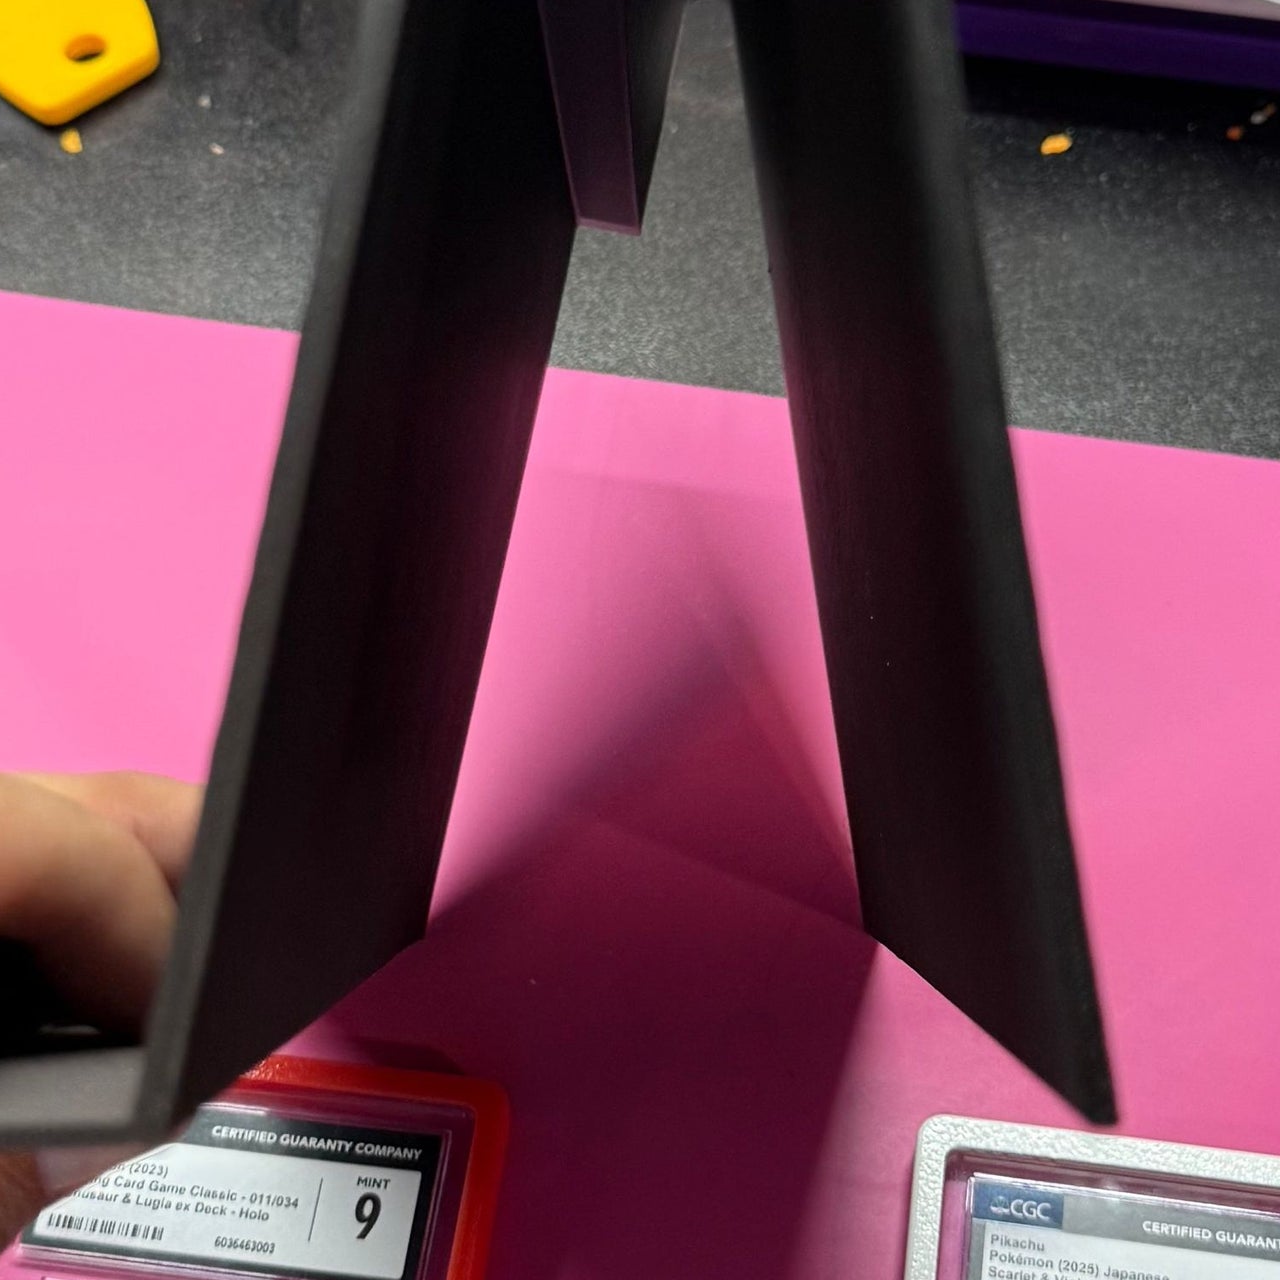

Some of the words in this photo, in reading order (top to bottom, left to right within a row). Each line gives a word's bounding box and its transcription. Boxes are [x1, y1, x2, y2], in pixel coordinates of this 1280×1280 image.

[211, 1124, 278, 1144] CERTIFIED
[279, 1132, 354, 1153] GUARANTY
[354, 1141, 423, 1161] COMPANY
[128, 1163, 169, 1179] (2023)
[113, 1175, 145, 1192] Card
[148, 1179, 187, 1196] Game
[189, 1184, 238, 1202] Classic
[249, 1191, 300, 1210] 011/034
[356, 1175, 392, 1191] MINT
[73, 1188, 119, 1206] nusaur
[121, 1192, 133, 1206] &
[136, 1194, 172, 1212] Lugia
[175, 1200, 191, 1213] ex
[195, 1200, 228, 1217] Deck
[239, 1206, 270, 1222] Holo
[354, 1191, 383, 1241] 9
[1010, 1198, 1052, 1221] CGC
[1142, 1220, 1212, 1241] CERTIFIED
[214, 1235, 276, 1255] 6036463003
[990, 1233, 1045, 1252] Pikachu
[989, 1250, 1054, 1269] Pokémon
[1058, 1259, 1100, 1278] (2025)
